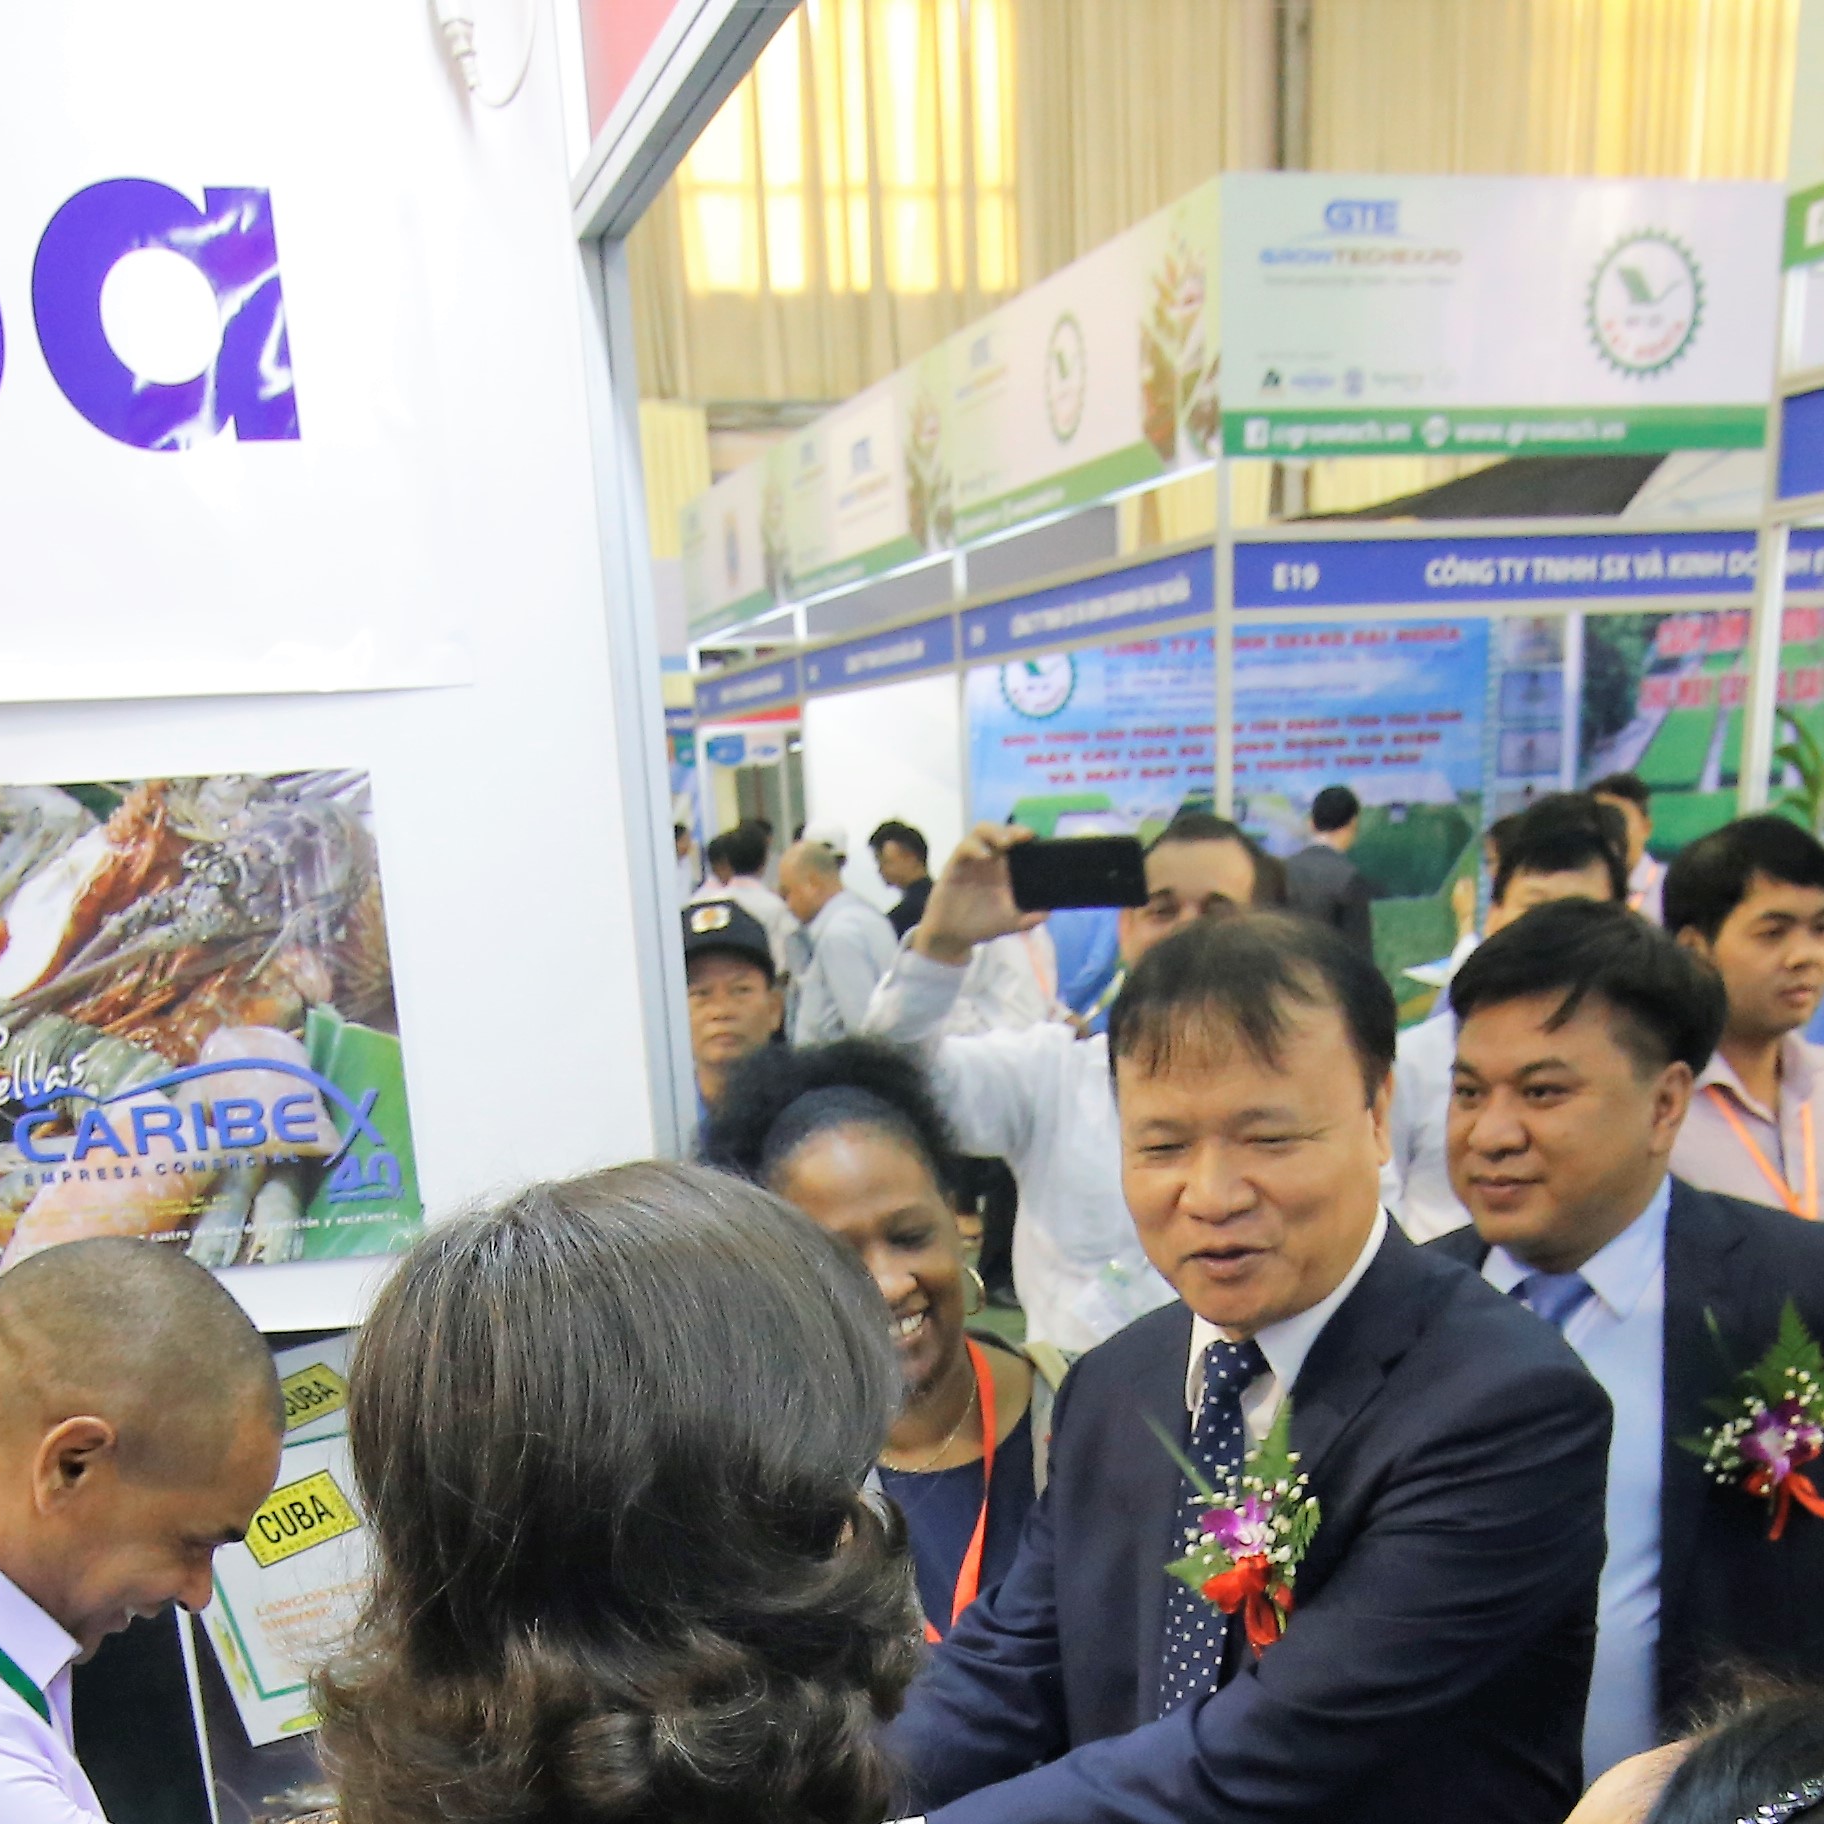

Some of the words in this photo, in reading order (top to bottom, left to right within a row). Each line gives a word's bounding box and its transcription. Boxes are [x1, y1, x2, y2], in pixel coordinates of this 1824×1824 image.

[1272, 562, 1320, 592] E19
[1426, 553, 1495, 586] CÔNG
[1498, 557, 1526, 584] TY
[12, 1088, 385, 1167] CARIBEX
[256, 1494, 336, 1544] CUBA
